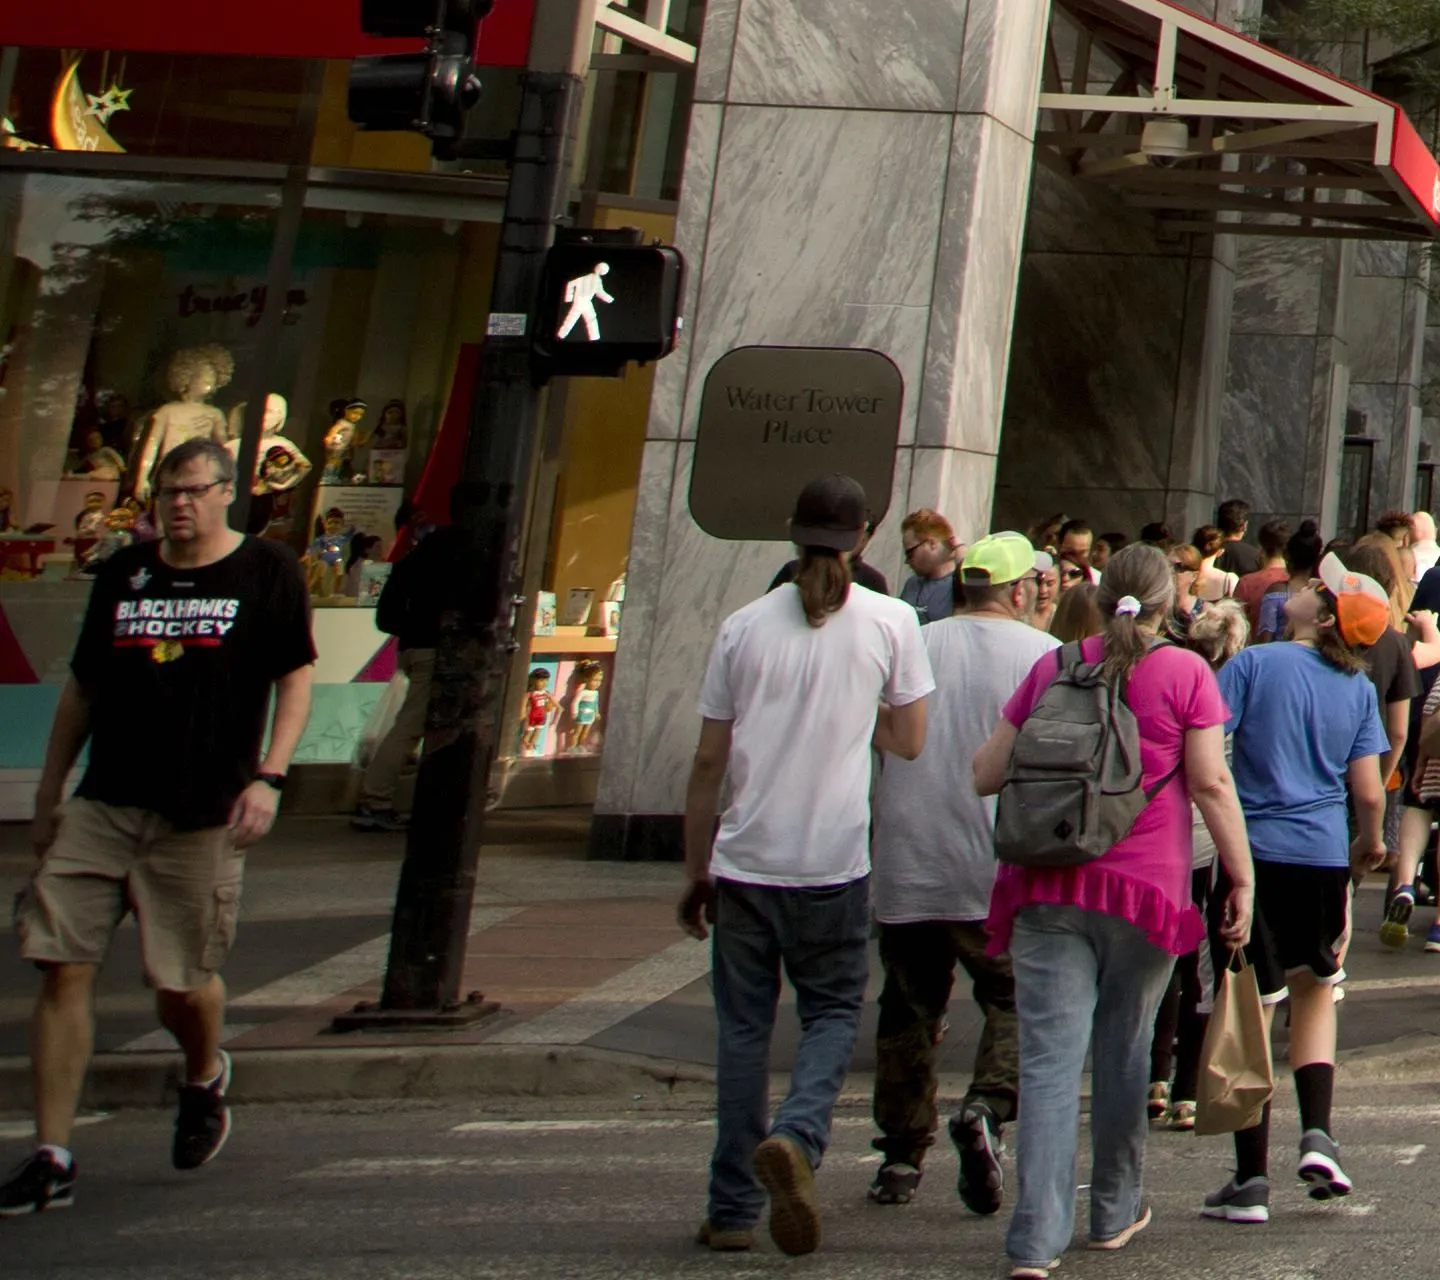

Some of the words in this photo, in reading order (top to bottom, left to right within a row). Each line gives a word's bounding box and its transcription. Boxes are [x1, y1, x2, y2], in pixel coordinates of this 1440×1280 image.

[725, 385, 799, 413] Water
[801, 388, 883, 415] Tower
[763, 419, 833, 445] Place
[115, 598, 240, 620] BLACKHAWKS
[128, 619, 234, 636] HOCKEY
